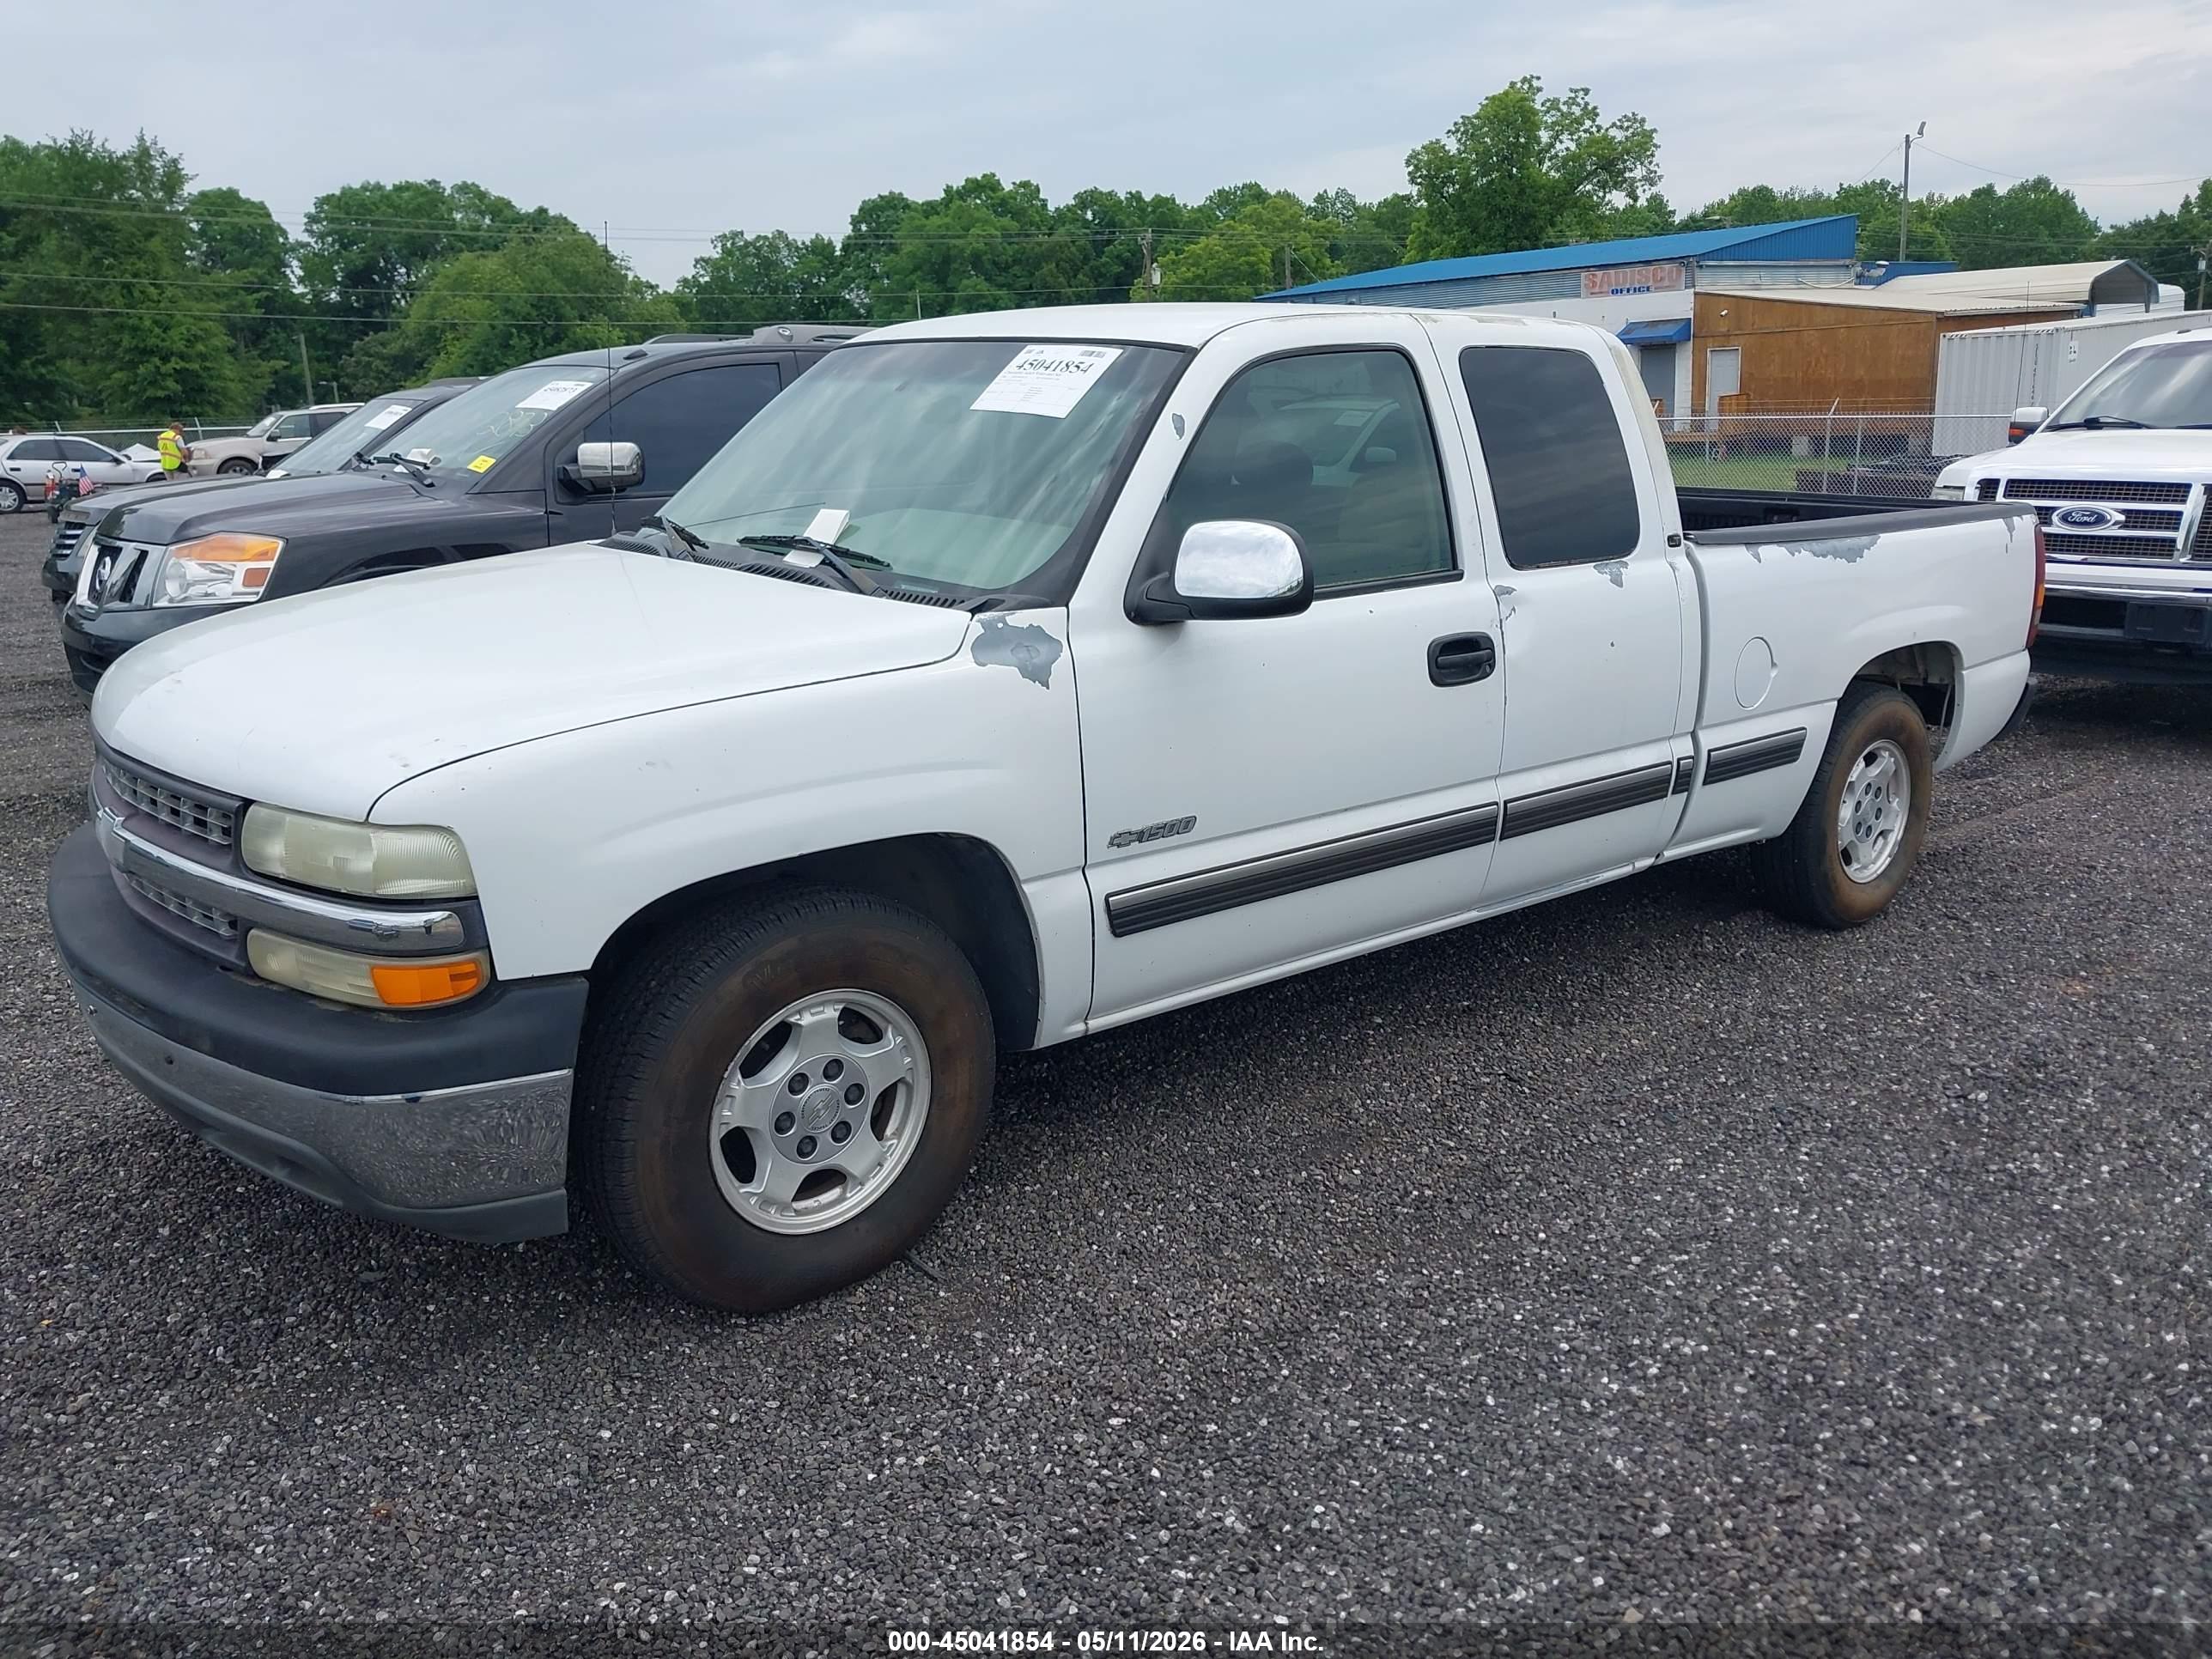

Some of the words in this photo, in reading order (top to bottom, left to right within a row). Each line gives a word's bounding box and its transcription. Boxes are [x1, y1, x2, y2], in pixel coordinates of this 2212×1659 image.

[1610, 285, 1653, 295] OFFICE
[1016, 357, 1096, 374] 45041854
[2068, 510, 2097, 522] Ford
[1669, 536, 1680, 545] LT
[1139, 815, 1197, 843] 1500
